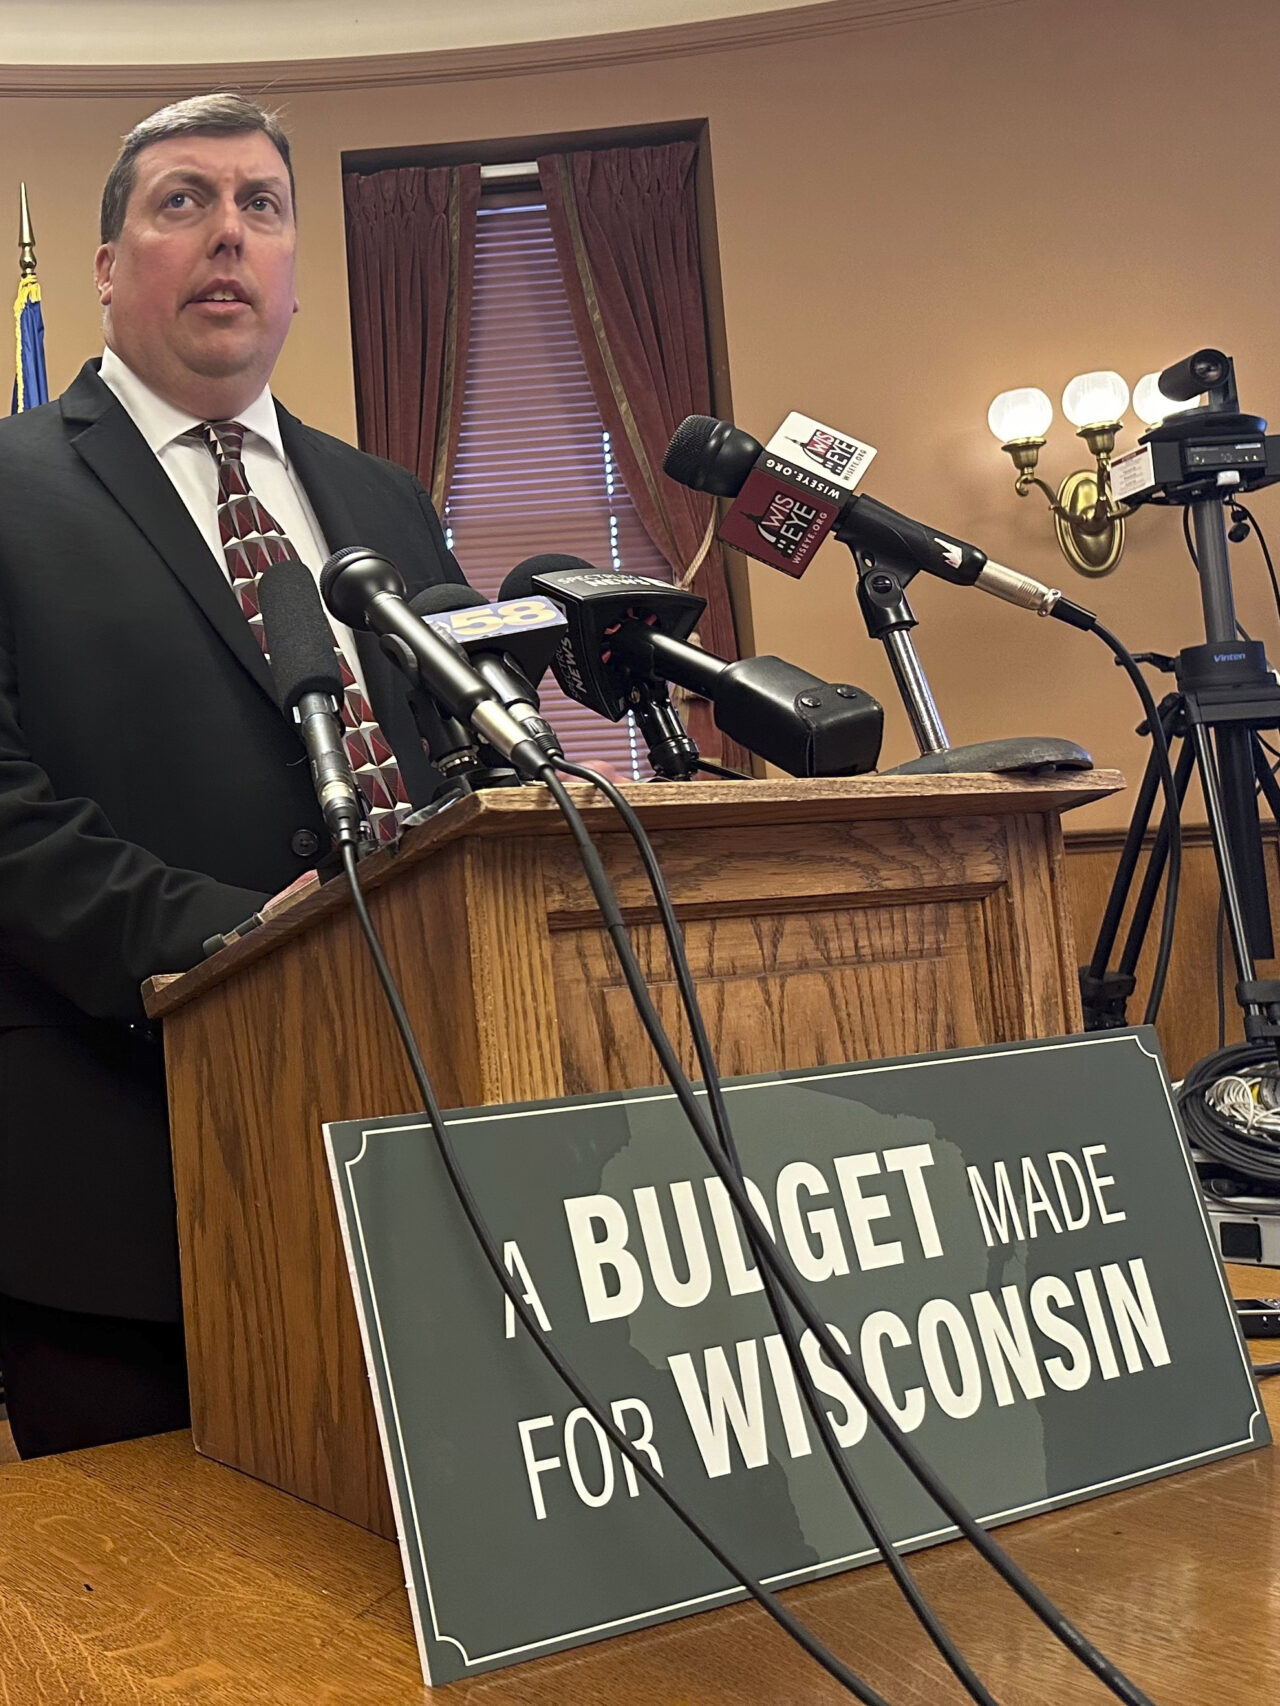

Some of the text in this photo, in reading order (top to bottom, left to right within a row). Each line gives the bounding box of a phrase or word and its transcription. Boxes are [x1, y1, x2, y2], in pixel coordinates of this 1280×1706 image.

[807, 431, 836, 455] WIS
[825, 437, 857, 466] EYE
[766, 459, 840, 500] WISEYE.ORG
[842, 449, 868, 481] WISEYE.ORG
[761, 494, 794, 529] WIS
[780, 501, 817, 541] EYE
[792, 512, 828, 565] WISEYE.ORG
[584, 578, 651, 588] NEWS
[449, 600, 557, 636] 58
[561, 636, 588, 693] NEWS
[1213, 653, 1246, 663] Vinten
[503, 1144, 1126, 1339] A BUDGET MADE
[517, 1258, 1171, 1520] FOR WISCONSIN
